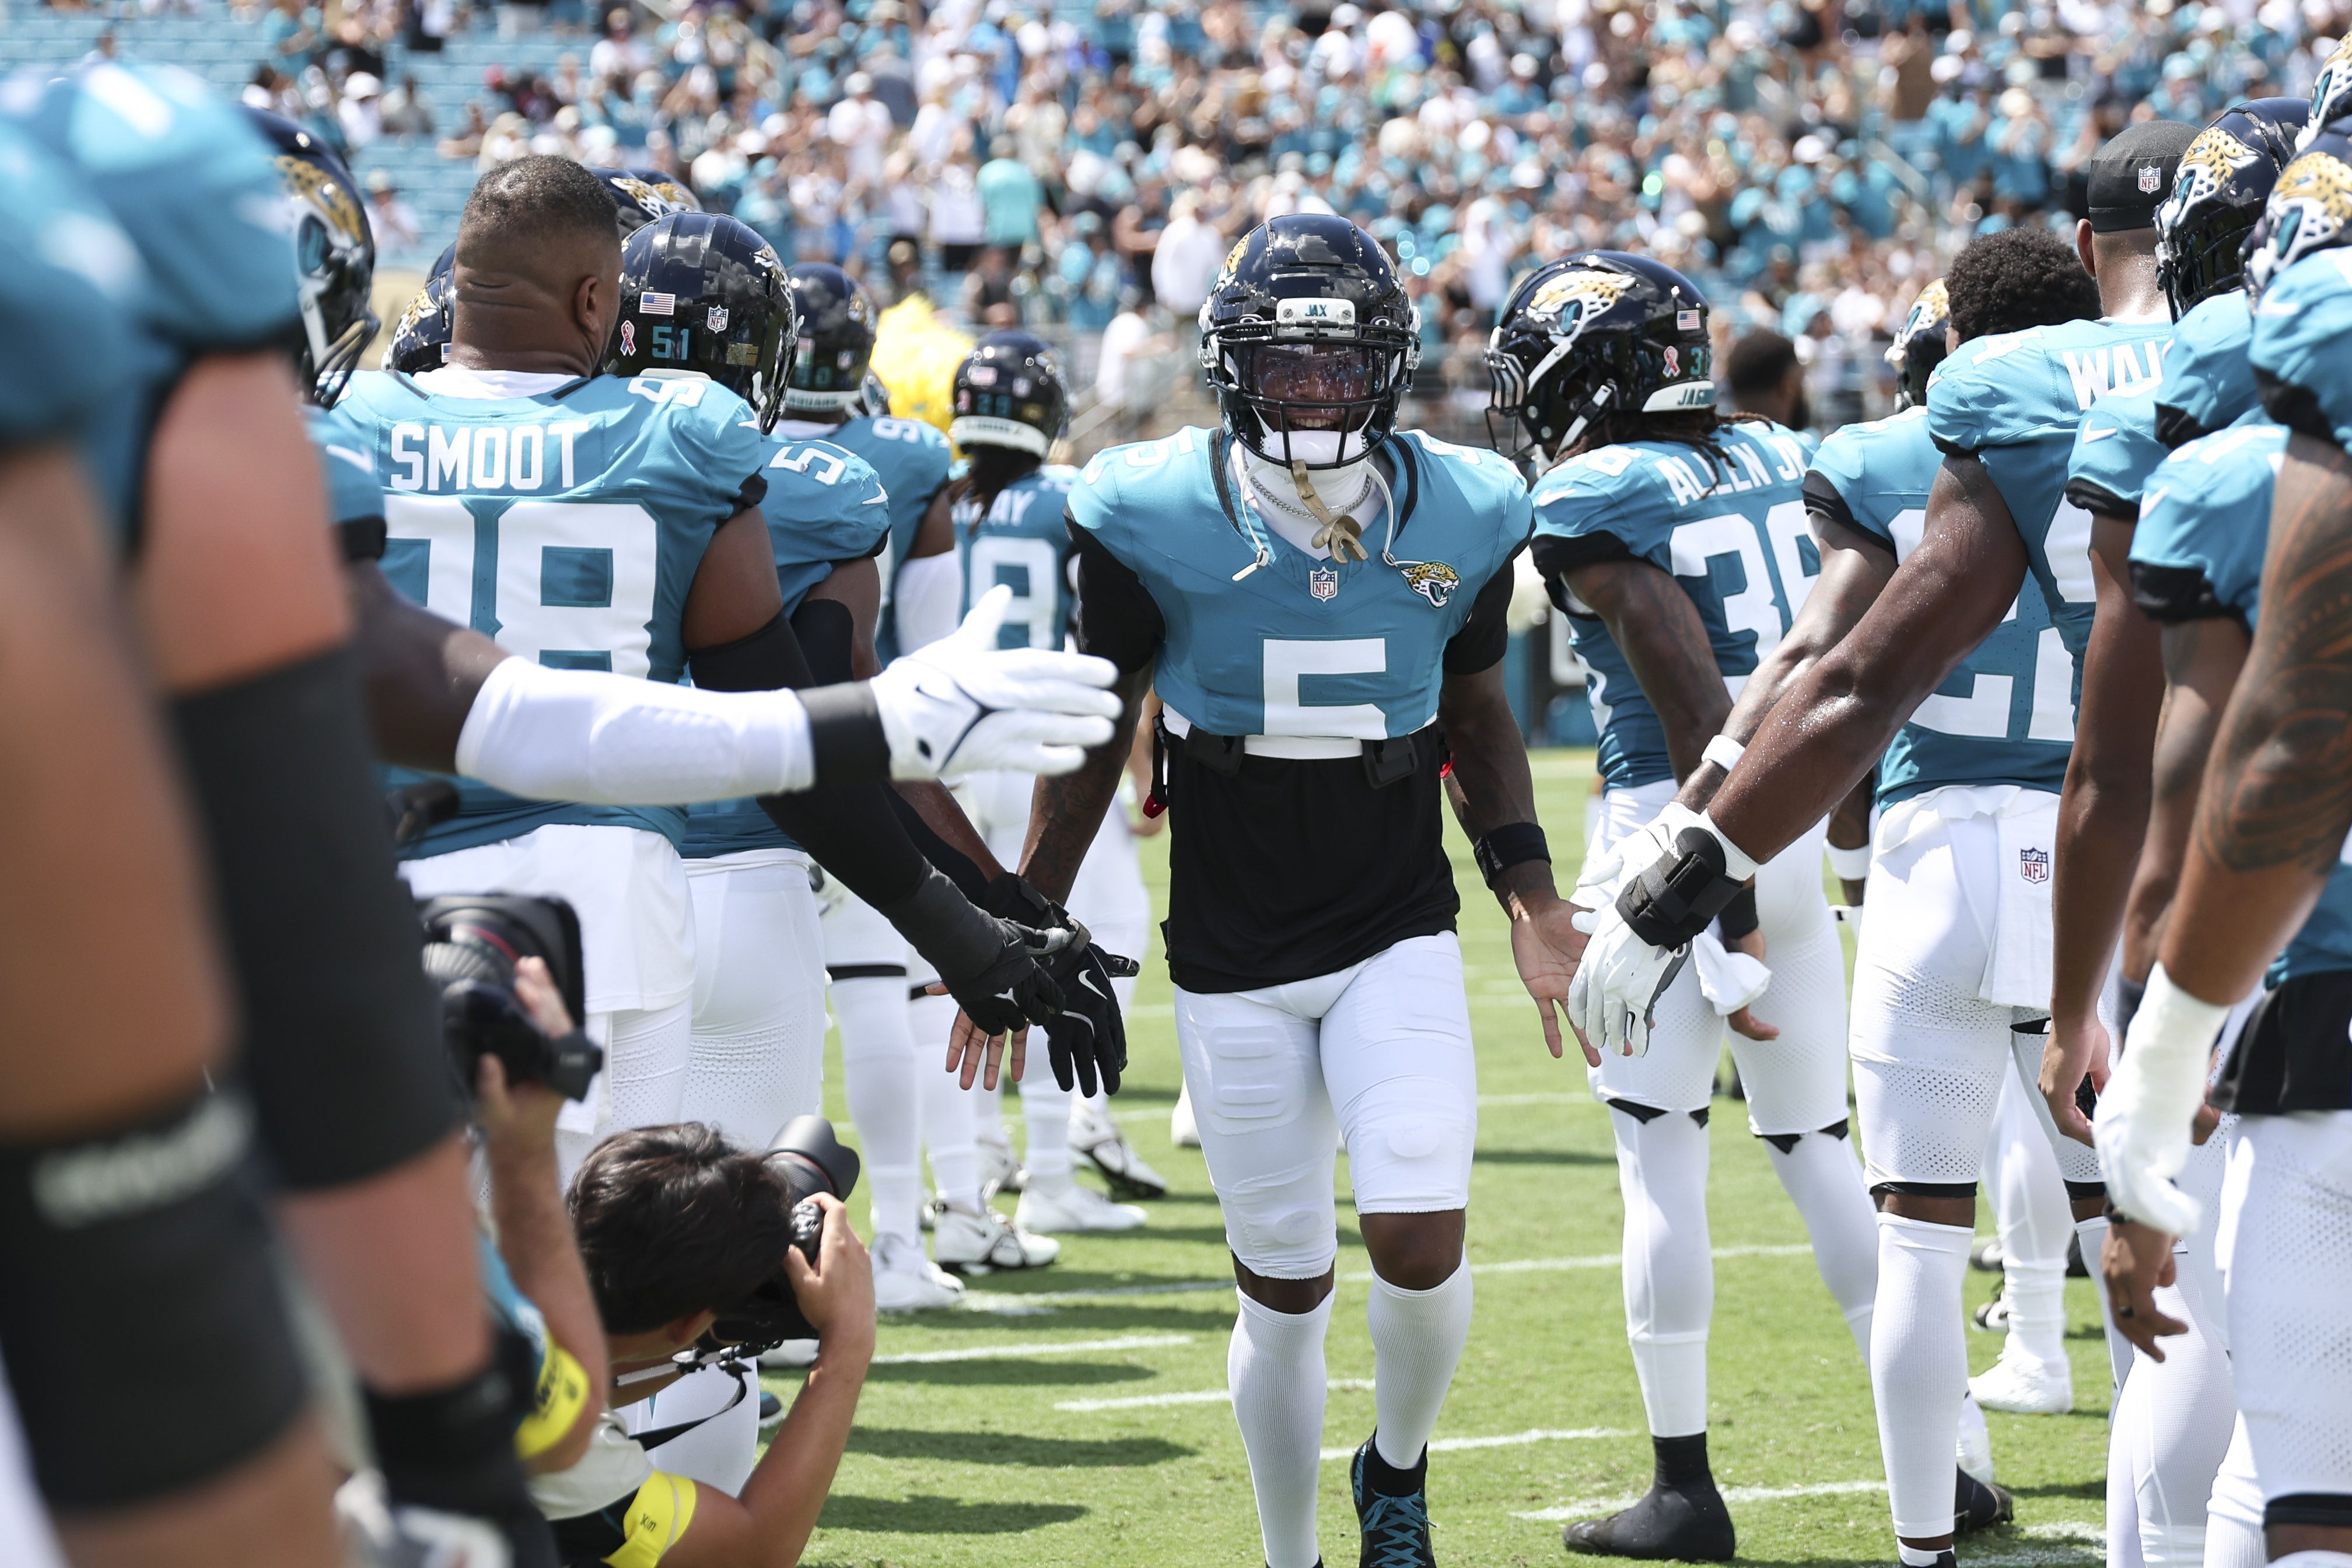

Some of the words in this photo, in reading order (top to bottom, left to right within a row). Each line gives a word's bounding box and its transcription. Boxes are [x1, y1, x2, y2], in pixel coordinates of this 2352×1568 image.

[2141, 177, 2158, 190] NFL
[1304, 304, 1327, 317] JAX
[710, 317, 724, 328] NFL
[652, 326, 689, 360] 51
[391, 422, 589, 492] SMOOT
[1654, 441, 1773, 507] ALLEN
[1315, 583, 1334, 596] NFL
[2024, 862, 2046, 880] NFL
